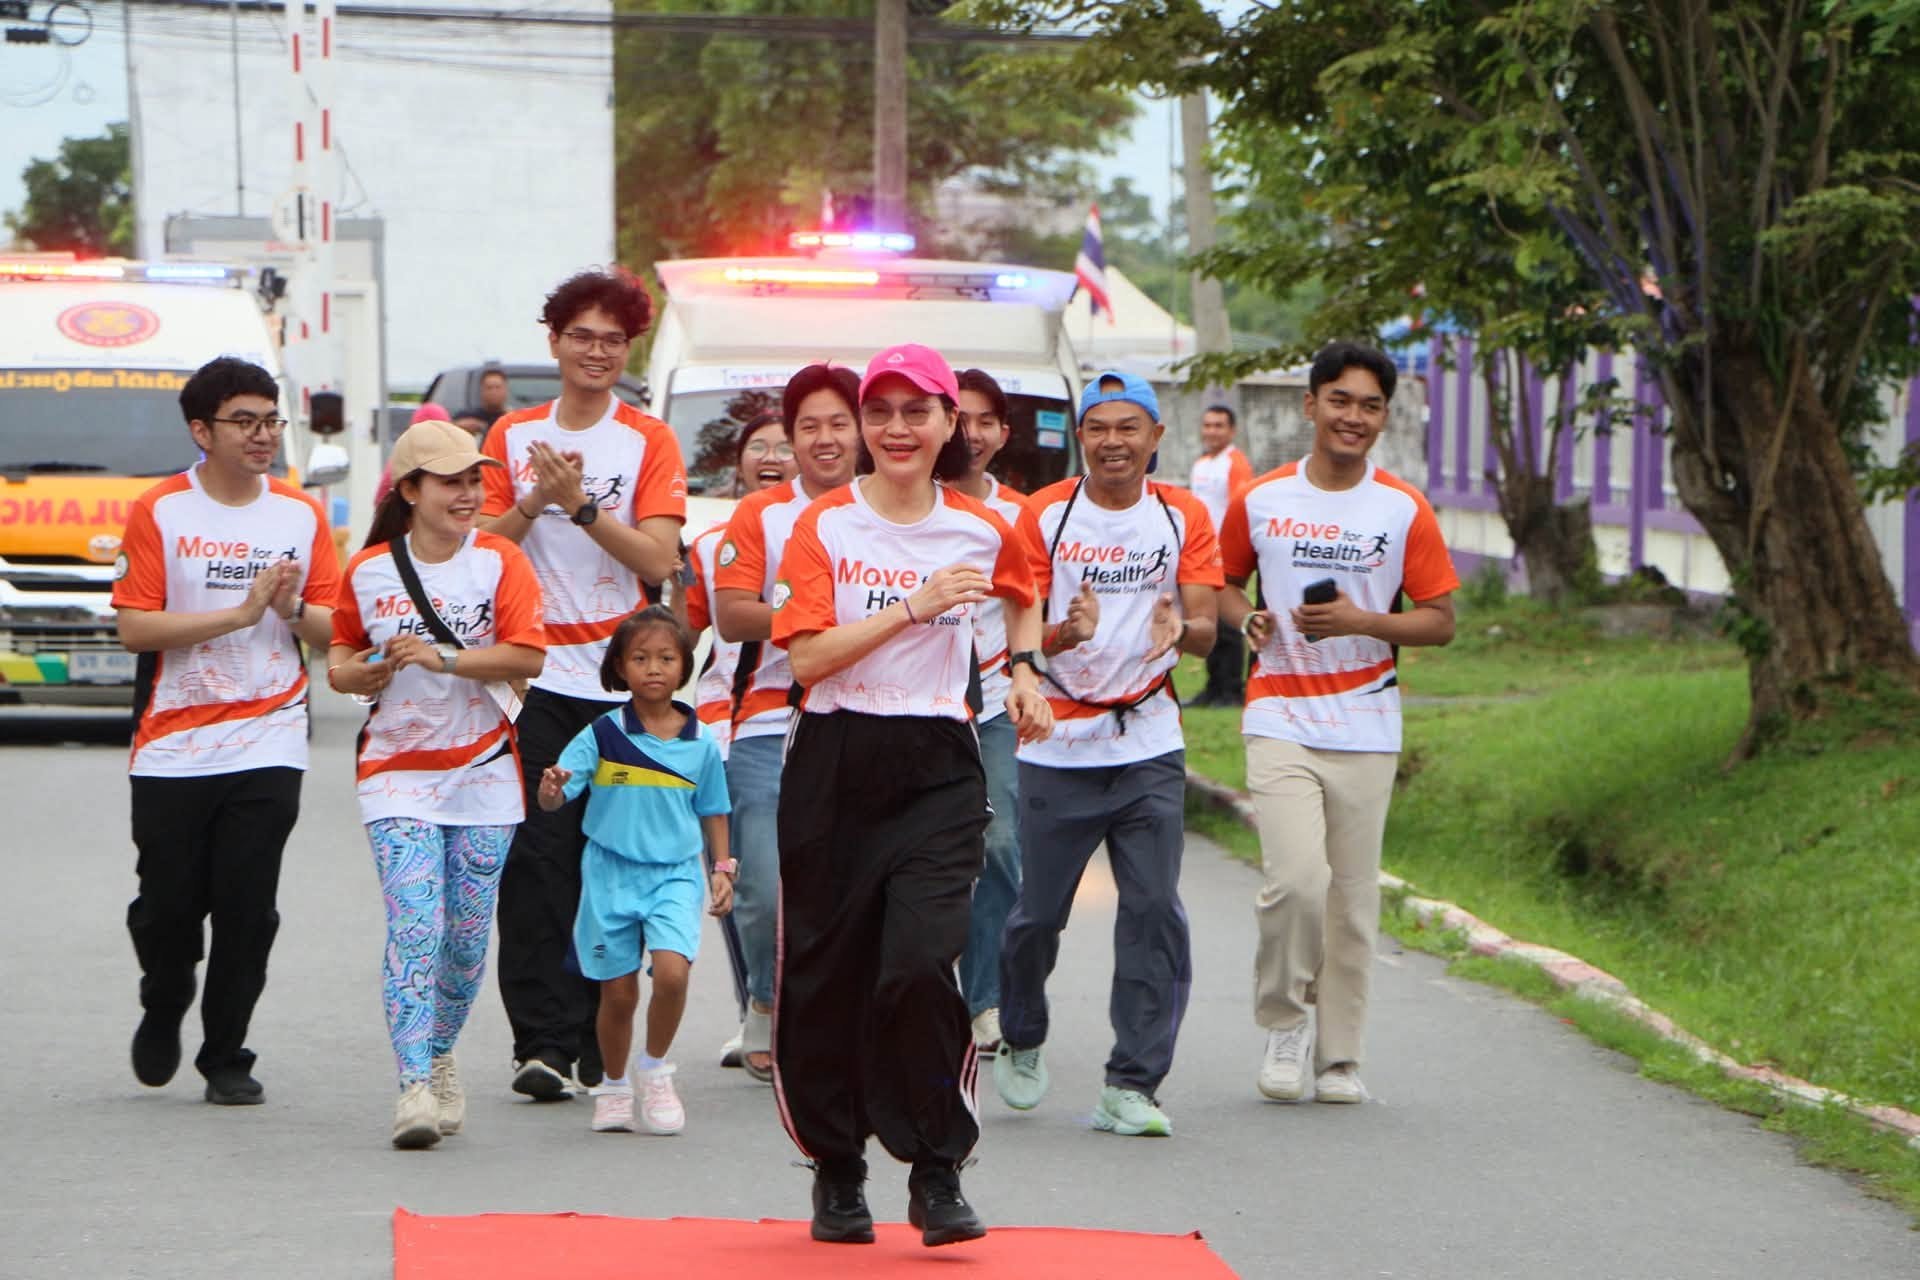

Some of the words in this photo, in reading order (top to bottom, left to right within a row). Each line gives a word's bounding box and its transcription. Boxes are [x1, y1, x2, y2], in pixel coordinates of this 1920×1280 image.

[1266, 518, 1340, 539] Move
[1343, 530, 1362, 541] for
[176, 535, 249, 559] Move
[253, 546, 272, 559] for
[1058, 541, 1125, 563] Move
[1127, 549, 1145, 562] for
[1292, 541, 1361, 561] Health
[838, 557, 918, 589] Move
[1081, 565, 1146, 583] Health
[375, 596, 444, 619] Moe
